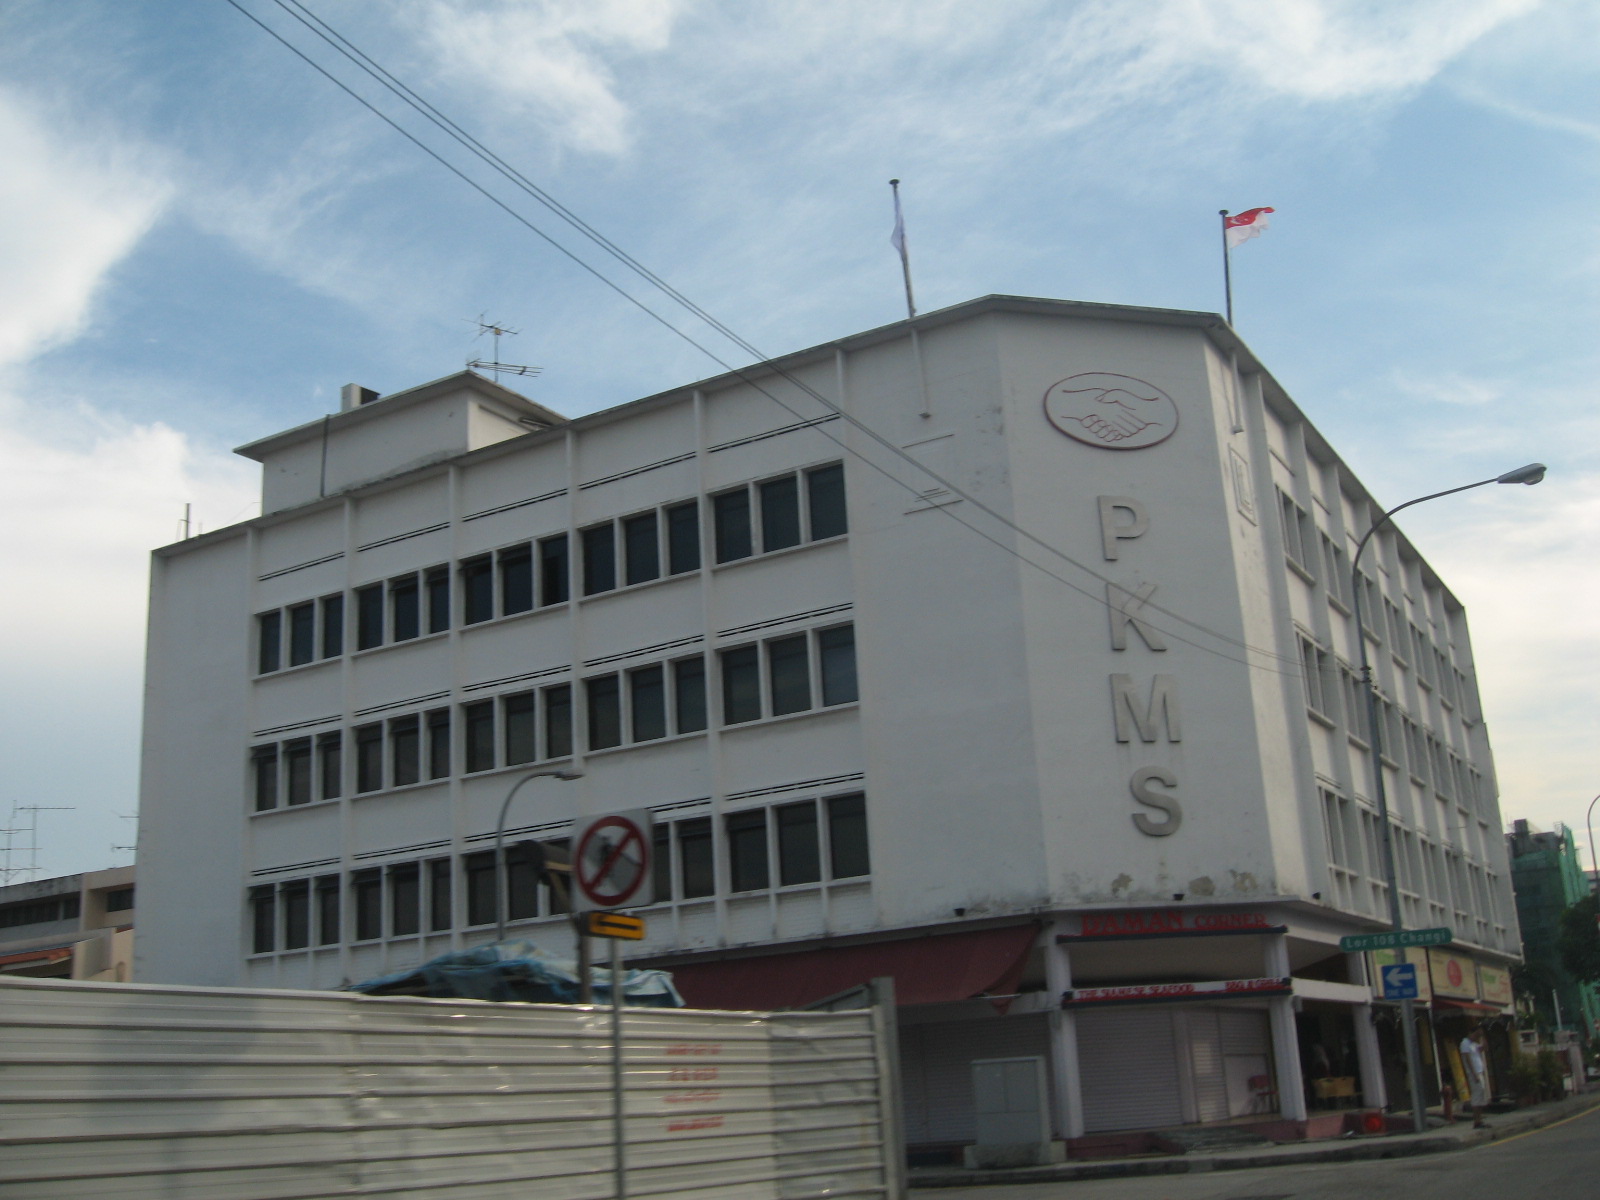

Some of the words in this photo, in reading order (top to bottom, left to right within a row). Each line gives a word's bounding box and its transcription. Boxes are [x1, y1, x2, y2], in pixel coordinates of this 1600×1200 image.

[1097, 495, 1183, 837] PKMS
[1345, 937, 1367, 949] Lor
[1400, 931, 1446, 943] Changi
